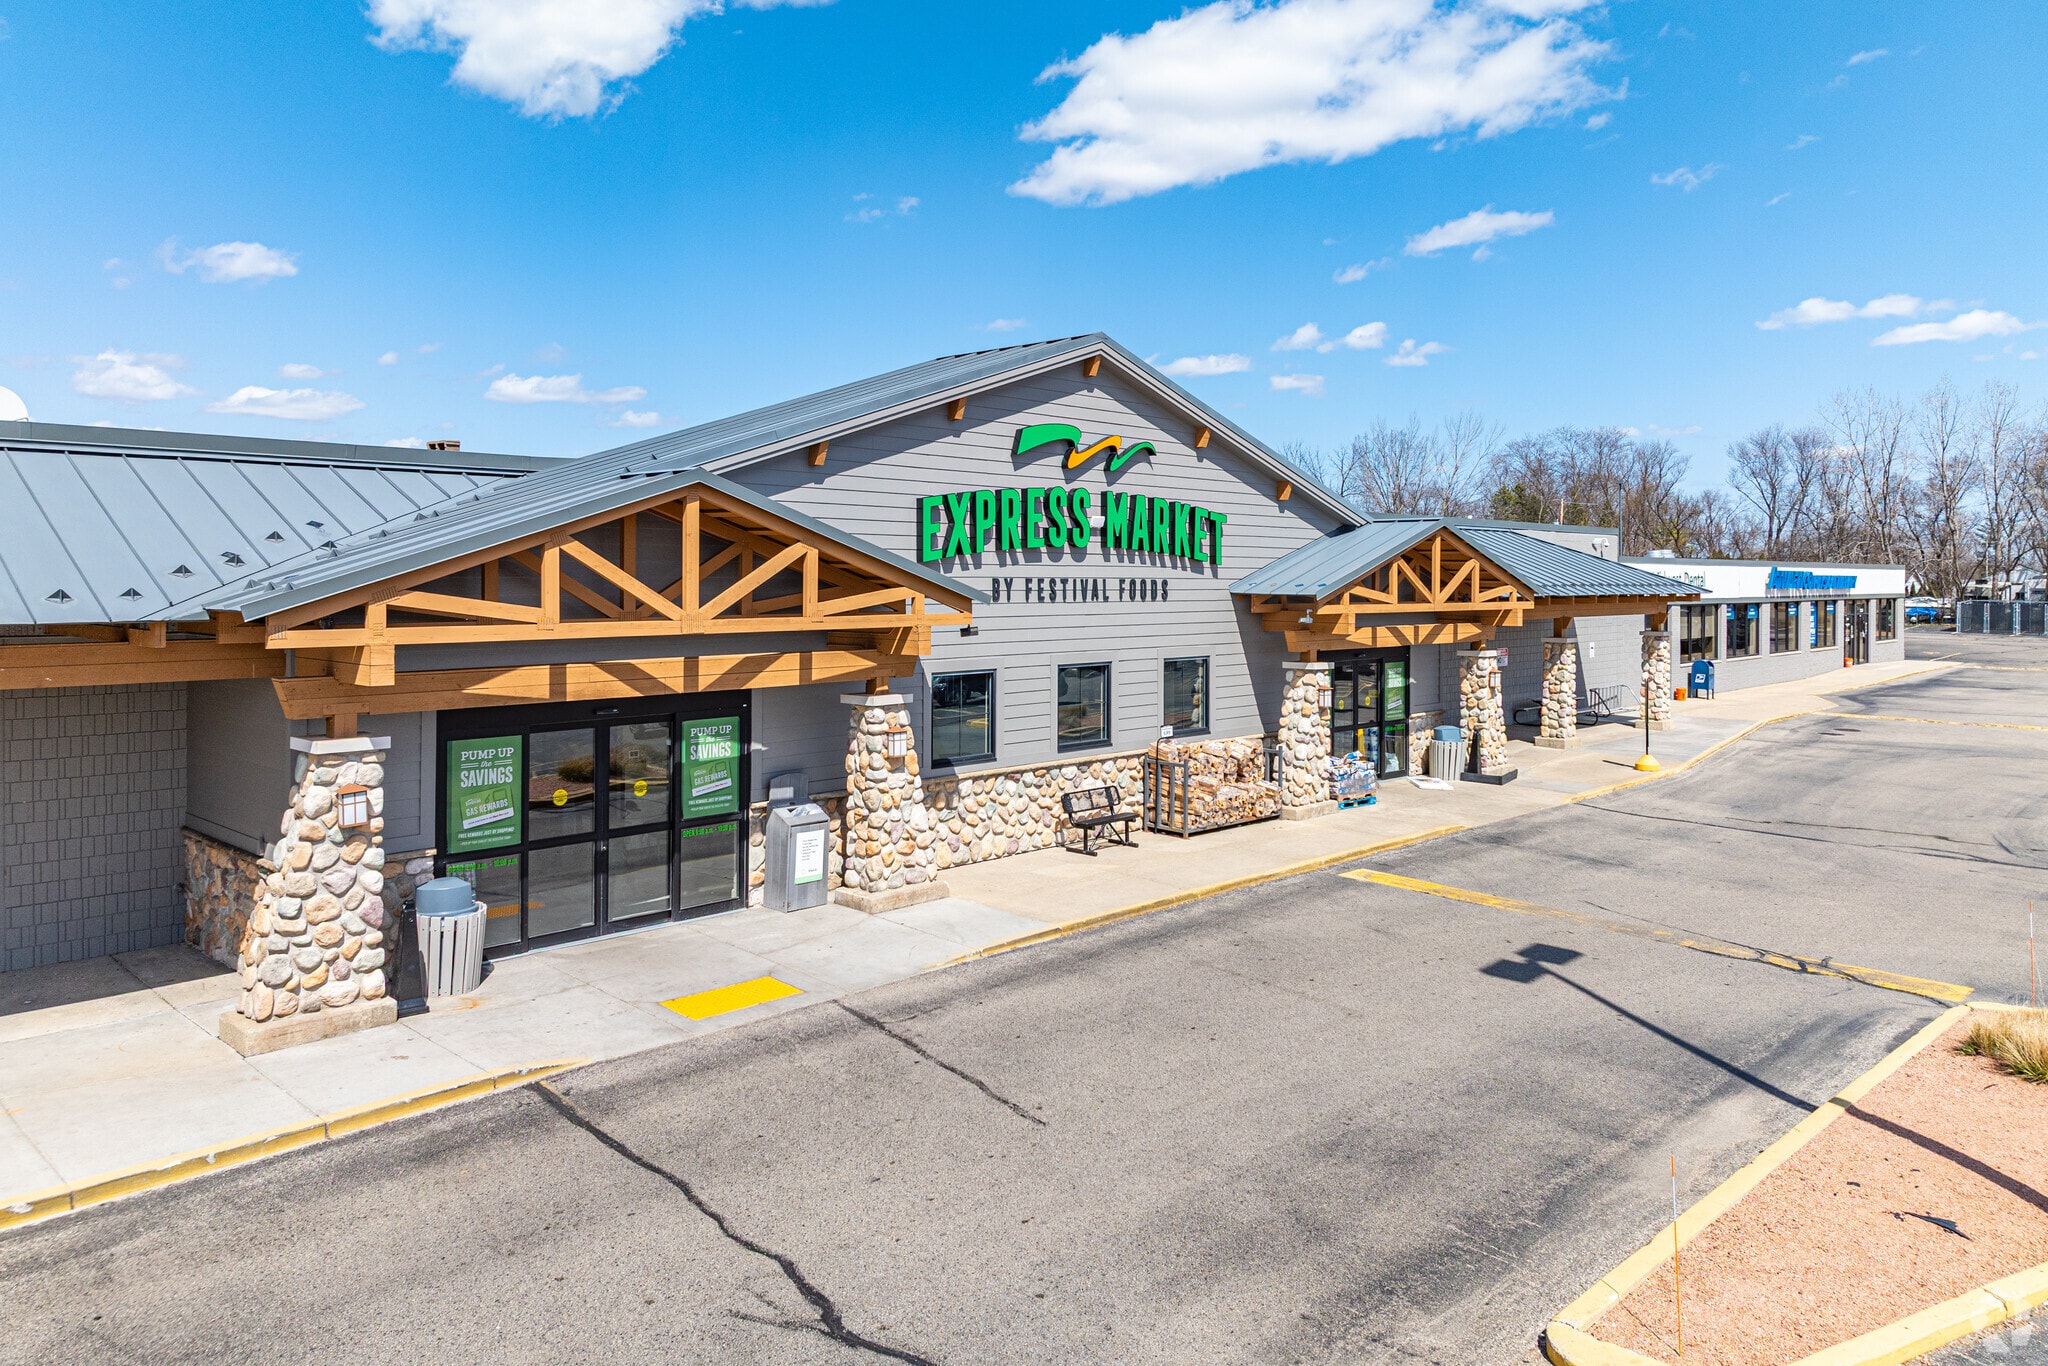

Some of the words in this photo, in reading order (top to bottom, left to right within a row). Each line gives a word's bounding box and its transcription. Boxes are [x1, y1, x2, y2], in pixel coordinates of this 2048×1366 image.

[920, 486, 1091, 562] EXPRESS
[1103, 490, 1227, 566] MARKET
[992, 578, 1013, 602] BY
[1025, 578, 1109, 602] FESTIVAL
[1119, 578, 1169, 602] FOODS
[690, 726, 718, 737] PUMP
[719, 724, 732, 734] UP
[460, 749, 496, 761] PUMP
[497, 747, 514, 758] UP
[690, 741, 731, 761] SAVINGS
[480, 760, 493, 768] the
[460, 765, 513, 788] SAVINGS
[465, 806, 479, 817] GAS
[479, 798, 509, 814] REWARDS
